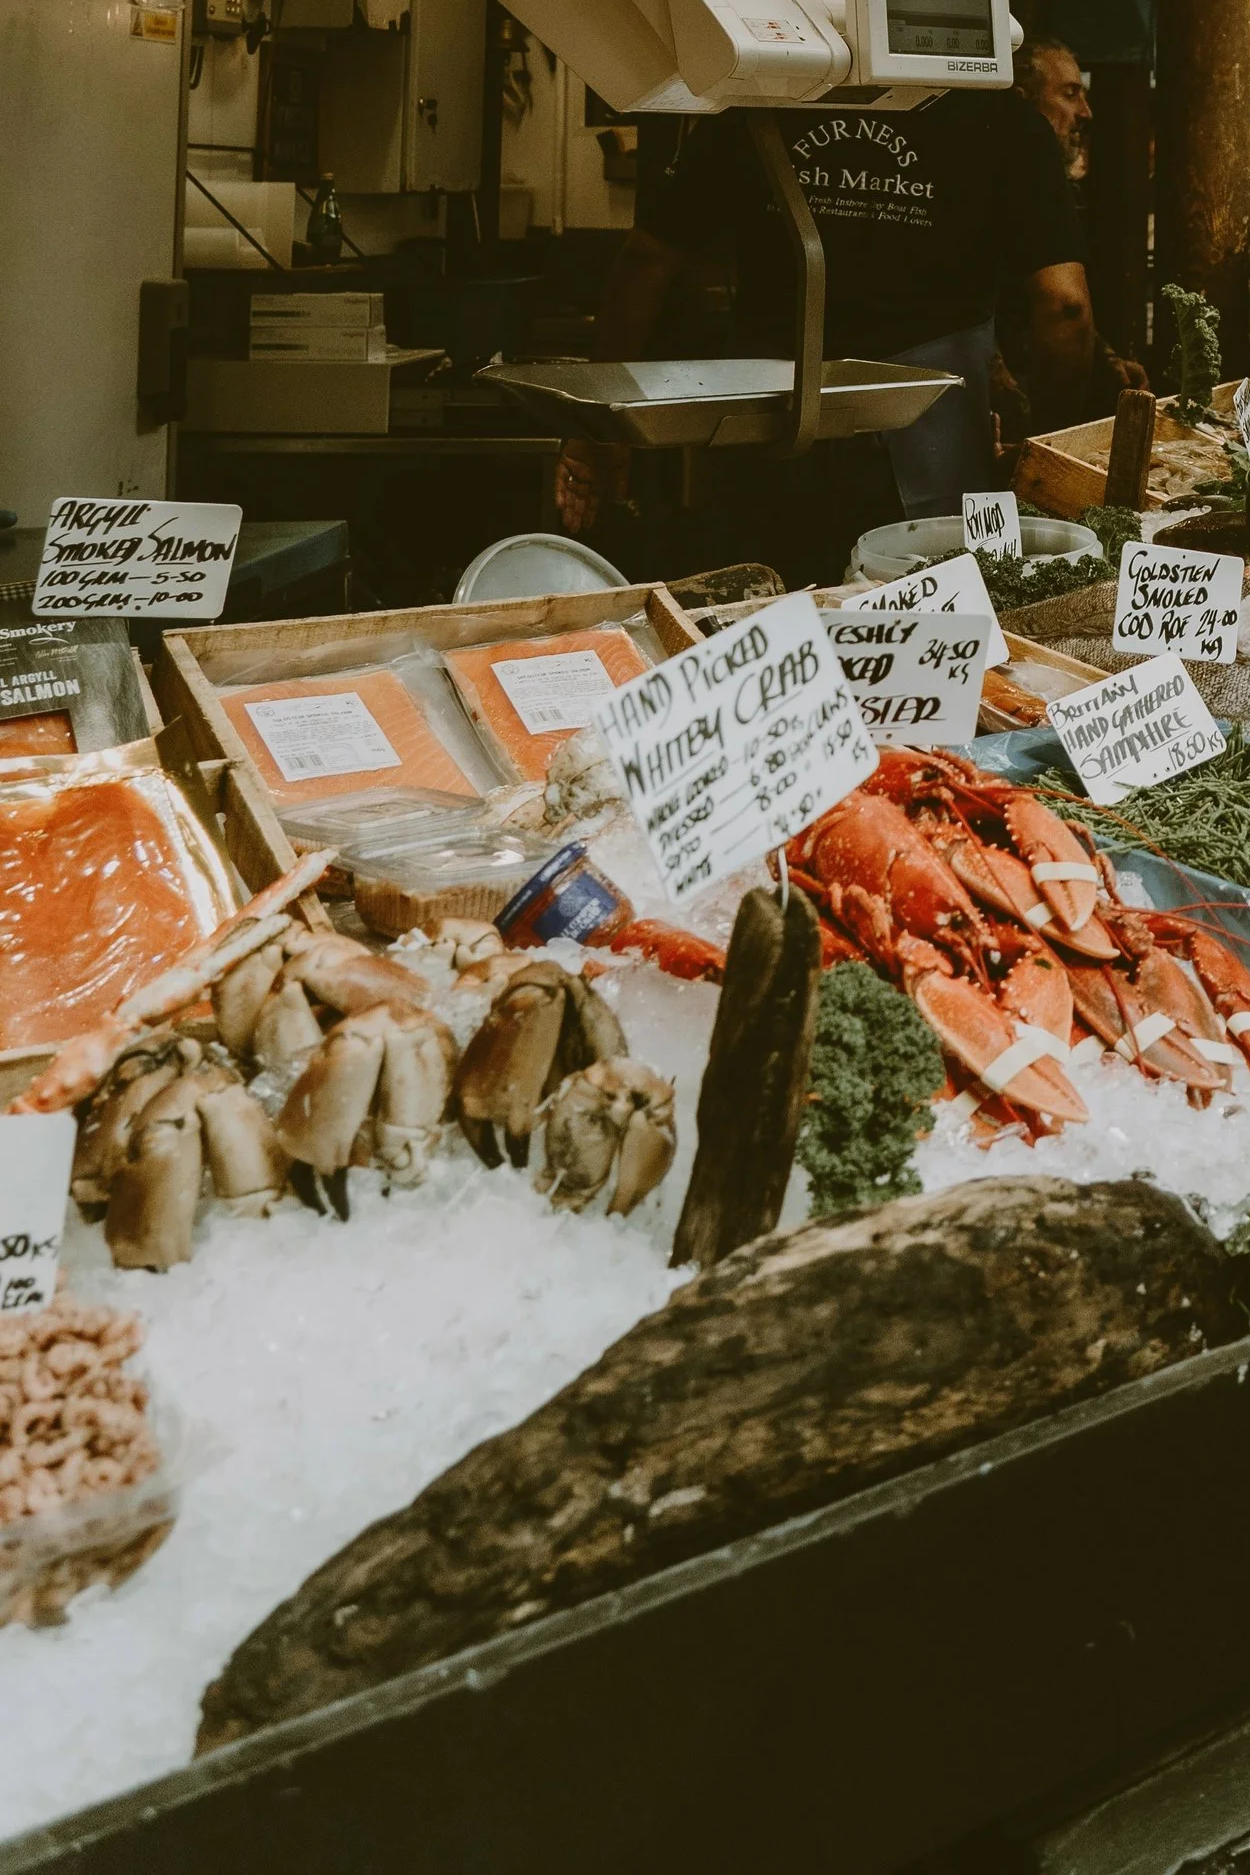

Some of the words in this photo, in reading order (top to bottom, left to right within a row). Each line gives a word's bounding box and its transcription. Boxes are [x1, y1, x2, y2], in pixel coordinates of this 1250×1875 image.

[947, 61, 998, 73] BIZERBA
[792, 118, 918, 167] FURNESS
[838, 168, 936, 200] Market
[836, 197, 868, 208] Inshore
[42, 533, 143, 567] SMOKED
[137, 516, 237, 564] SALMON
[1131, 584, 1208, 610] SMOKED
[0, 621, 77, 640] Smokery
[1118, 612, 1154, 639] COD
[1158, 609, 1192, 644] ROE
[0, 679, 80, 706] SALMON
[12, 670, 57, 686] ARGYLL
[599, 671, 672, 740] HAND
[620, 706, 725, 794] WHITBY
[734, 640, 820, 725] CRAB
[1063, 716, 1109, 754] HAND
[1112, 675, 1185, 736] GATHERED
[1080, 707, 1193, 780] SAMPHIRE
